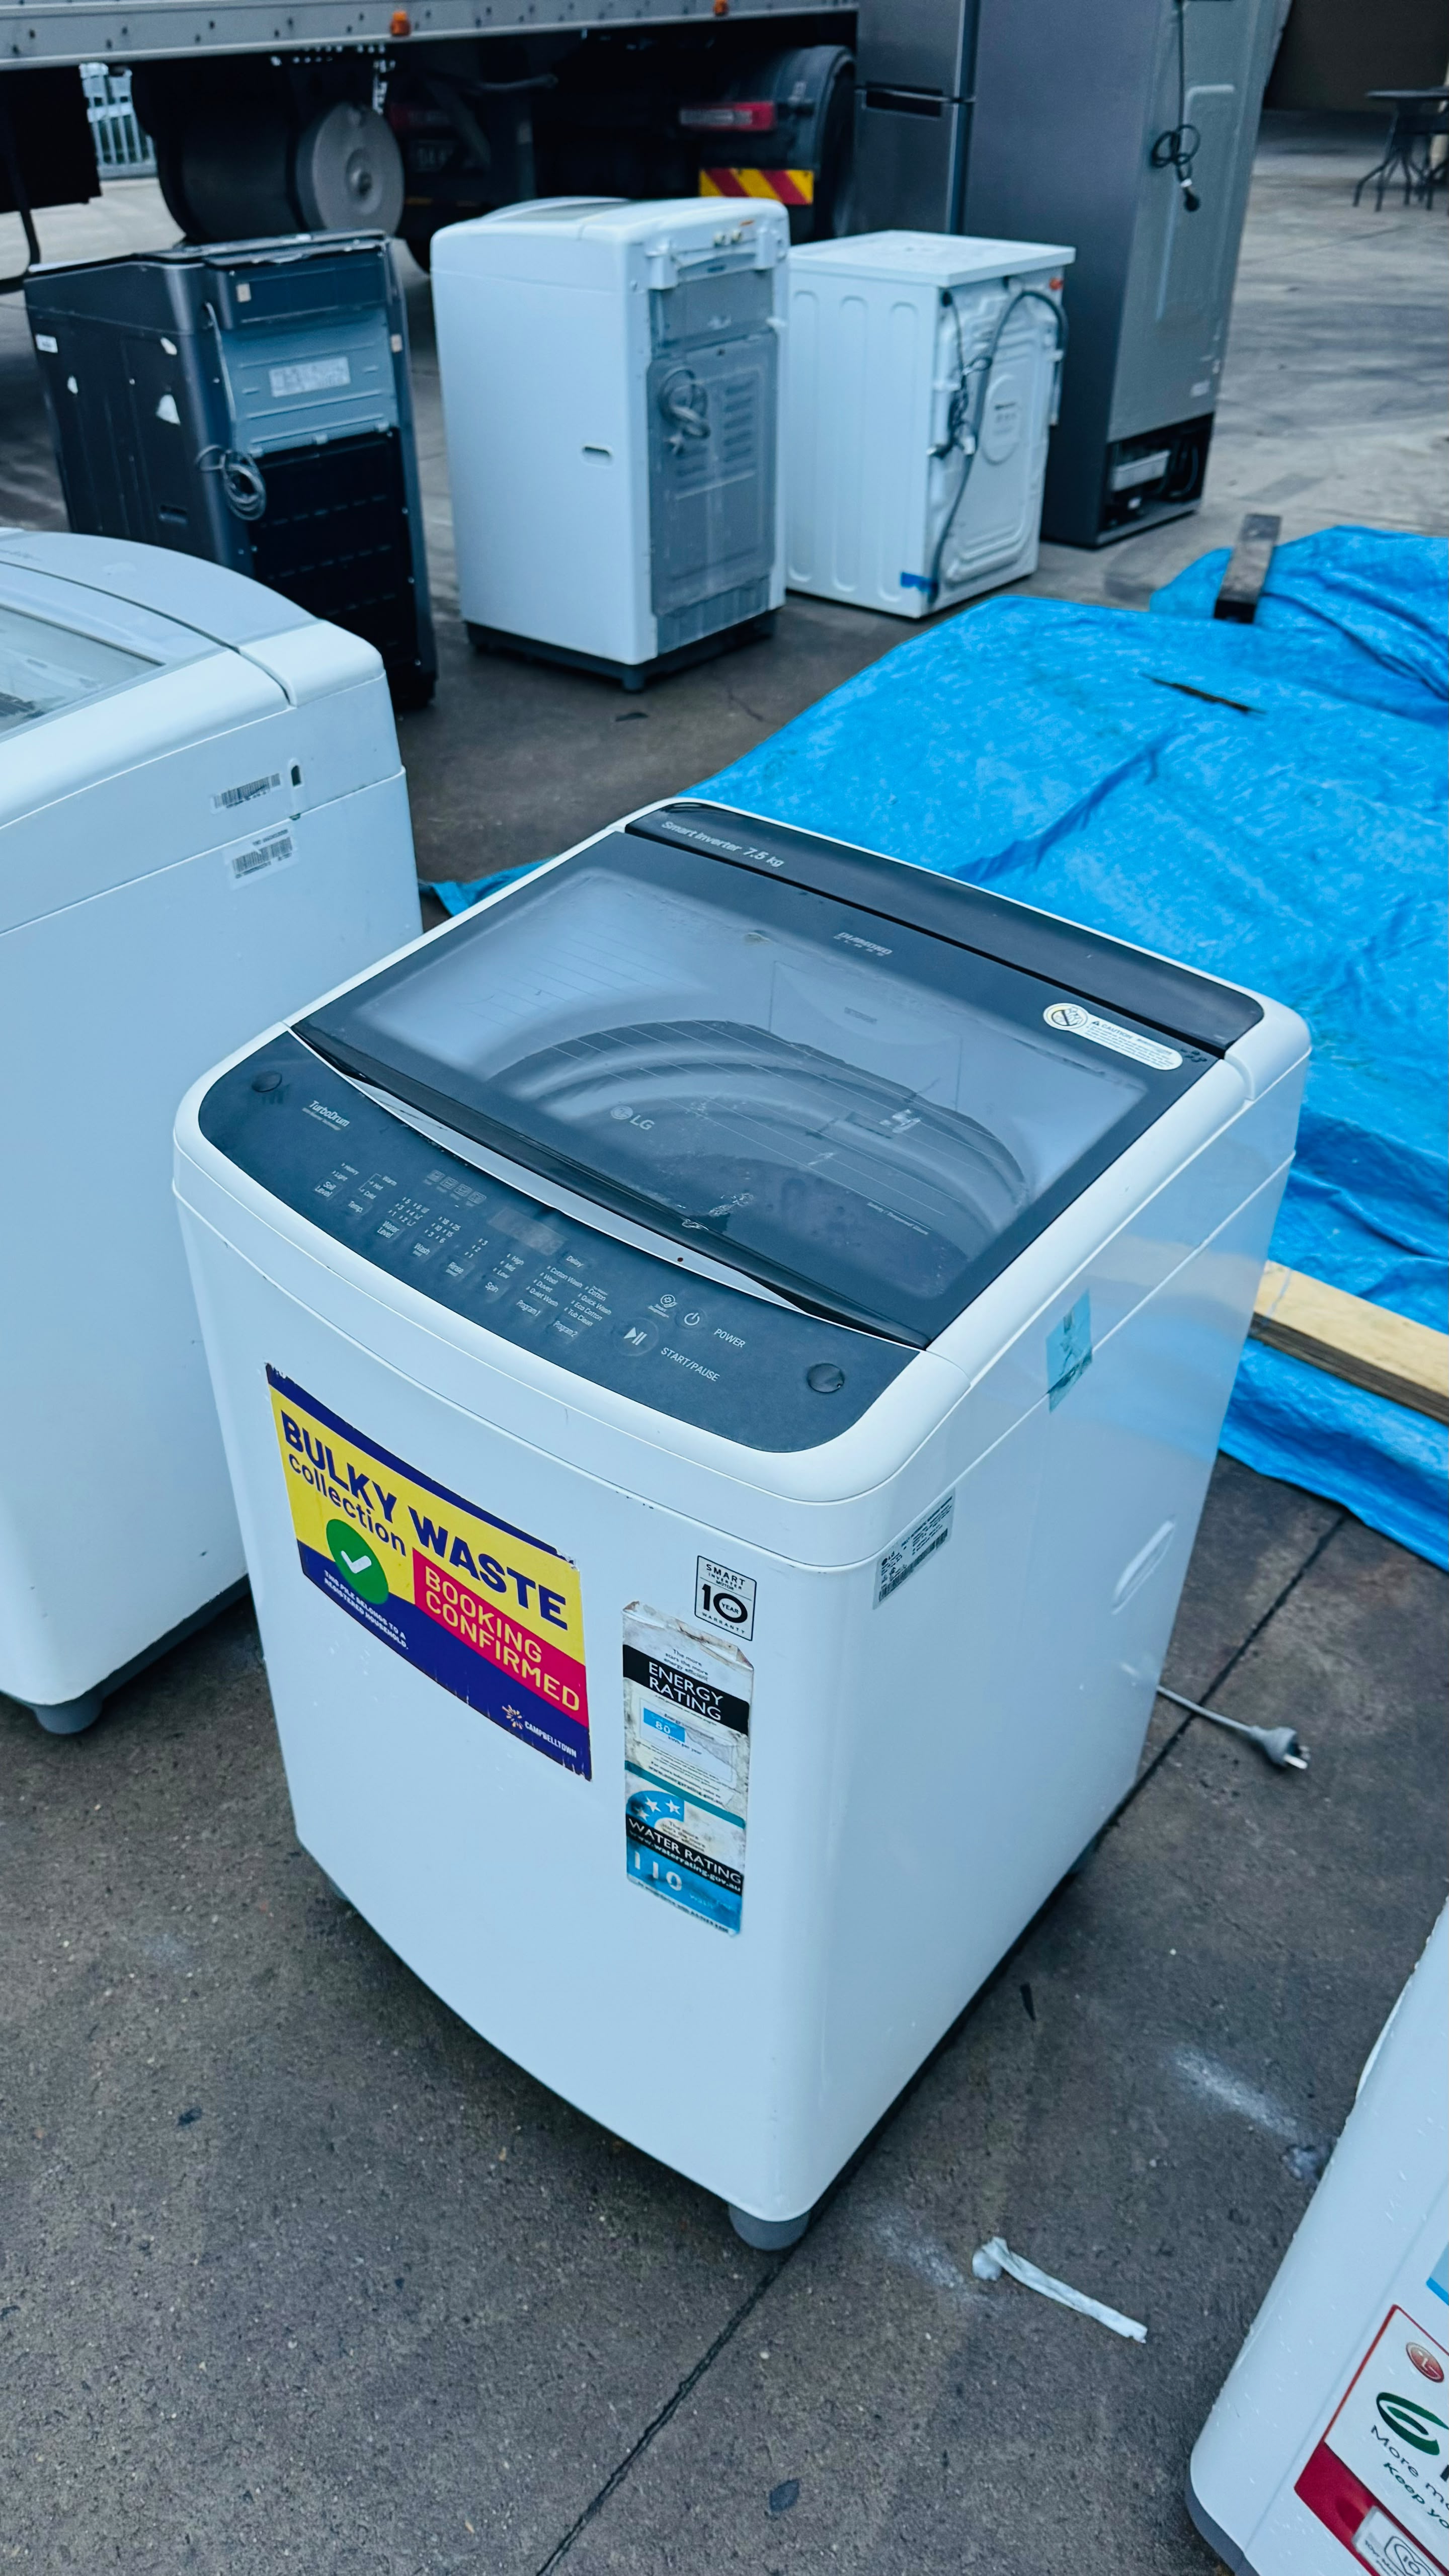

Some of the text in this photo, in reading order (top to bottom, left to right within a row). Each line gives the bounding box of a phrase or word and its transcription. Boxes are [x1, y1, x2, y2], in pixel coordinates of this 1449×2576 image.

[661, 821, 784, 867] Smart Inverter 7.5 kg
[1101, 1024, 1134, 1039] CAUTION
[309, 1100, 350, 1127] TurboDrum
[629, 1114, 655, 1130] LG
[314, 1185, 333, 1197] Level
[323, 1181, 337, 1190] Soil
[377, 1227, 393, 1238] Level
[382, 1221, 400, 1233] Water
[414, 1243, 430, 1255] Wash
[448, 1261, 464, 1274] Rinse
[566, 1255, 584, 1267] Delay
[497, 1269, 510, 1279] Low
[550, 1267, 583, 1288] Cotton Wash
[485, 1281, 499, 1293] Spin
[536, 1280, 552, 1293] Duvet
[588, 1289, 606, 1301] Cotton
[529, 1288, 558, 1307] Quiet Wash
[581, 1295, 611, 1315] Quick Wash
[568, 1309, 593, 1326] Tub Clean
[574, 1302, 602, 1321] Eco Cotton
[713, 1328, 746, 1348] POWER
[661, 1347, 720, 1382] START/PAUSE
[288, 1453, 407, 1557] collection
[281, 1409, 568, 1631] BULKY WASTE
[706, 1564, 746, 1585] SMART
[708, 1572, 742, 1590] INVERTER
[716, 1580, 735, 1591] MOTOR
[324, 1577, 364, 1615] REGISTERED
[324, 1569, 406, 1640] THIS PILE BELONGS TO A
[702, 1583, 748, 1624] 10
[425, 1565, 542, 1663] BOOKING
[721, 1602, 739, 1615] YEAR
[702, 1612, 745, 1634] WARRANTY
[426, 1590, 580, 1712] CONFIRMED
[686, 1656, 702, 1667] more
[692, 1666, 708, 1675] more
[649, 1661, 723, 1706] ENERGY
[649, 1676, 721, 1721] RATING
[656, 1721, 671, 1734] 80
[524, 1721, 577, 1758] CAMPBELLTOWN
[629, 1818, 742, 1884] WATER RATING
[1371, 2425, 1419, 2478] More
[1384, 2462, 1425, 2505] Keep
